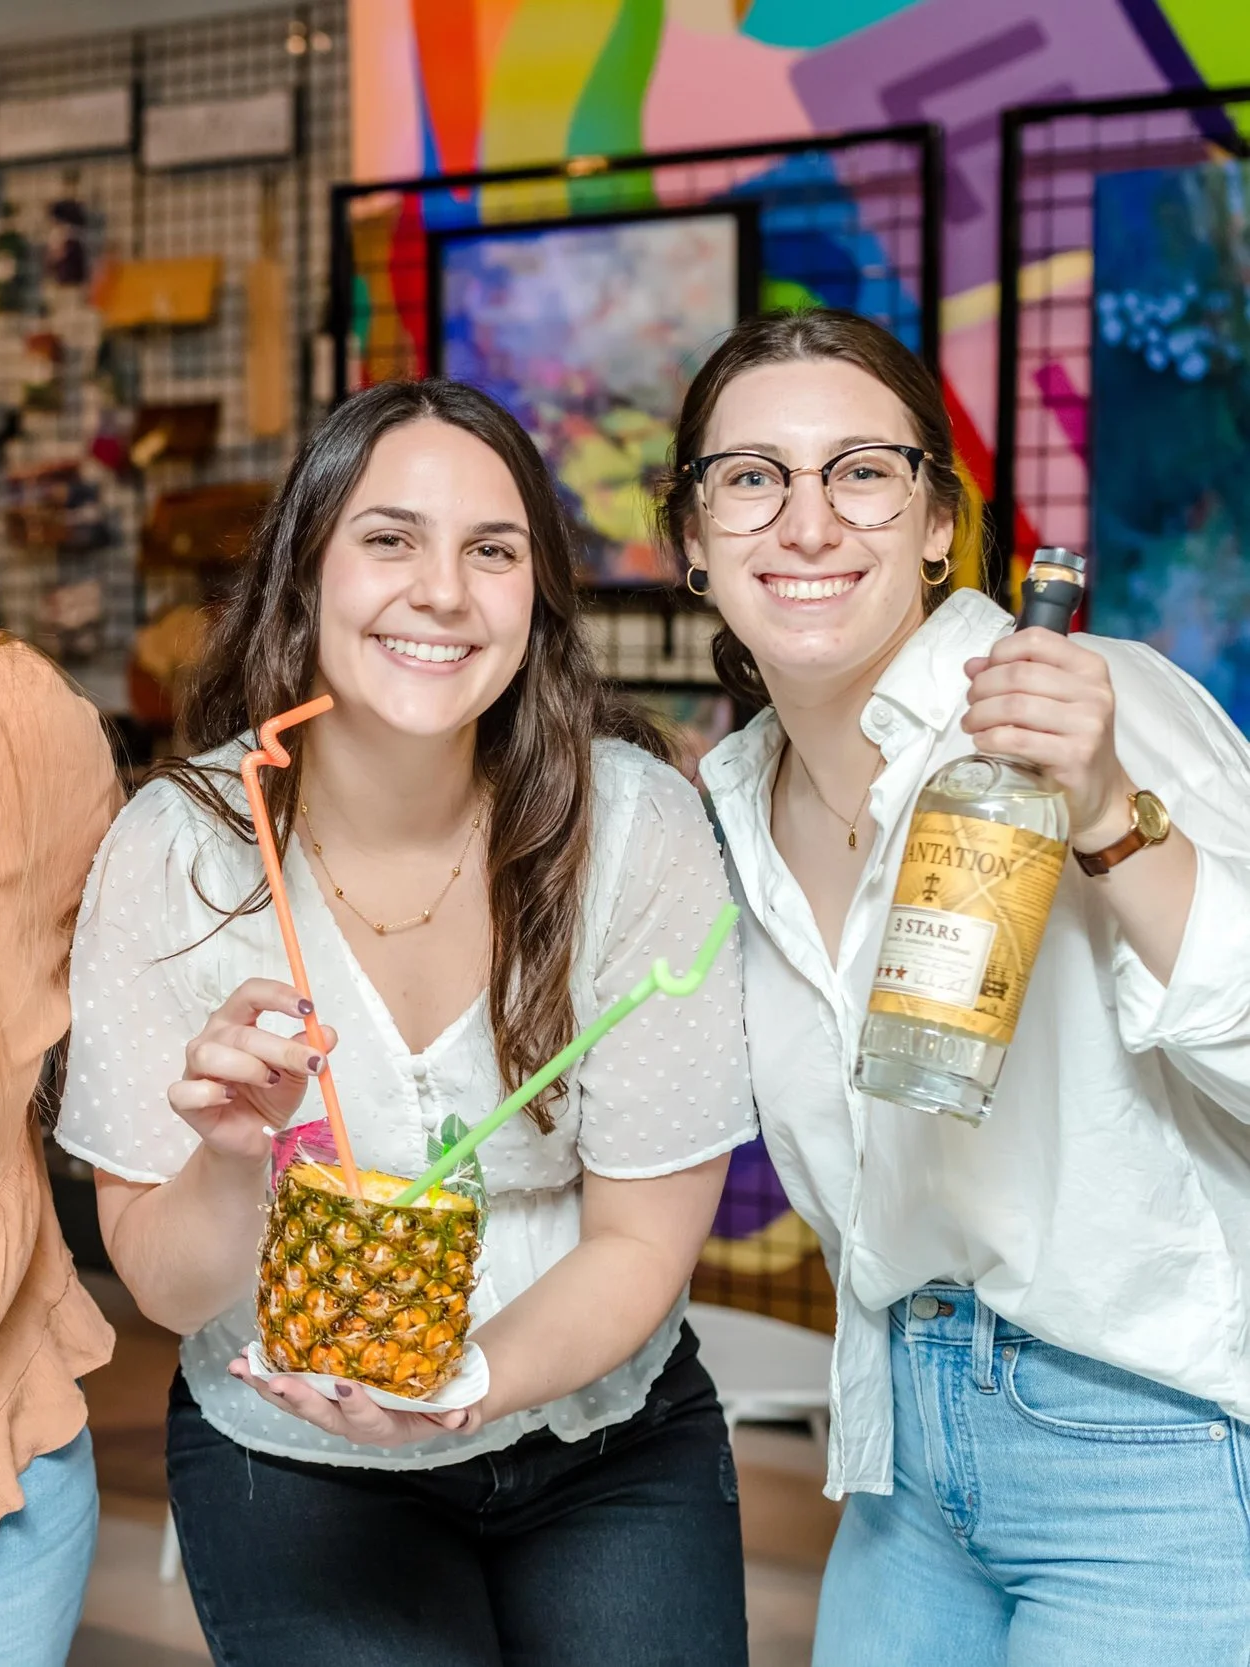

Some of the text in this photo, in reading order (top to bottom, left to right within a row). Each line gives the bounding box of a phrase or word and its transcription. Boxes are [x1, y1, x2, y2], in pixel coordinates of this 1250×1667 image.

[902, 842, 1016, 880] ANTATION
[894, 918, 962, 941] 3 STARS
